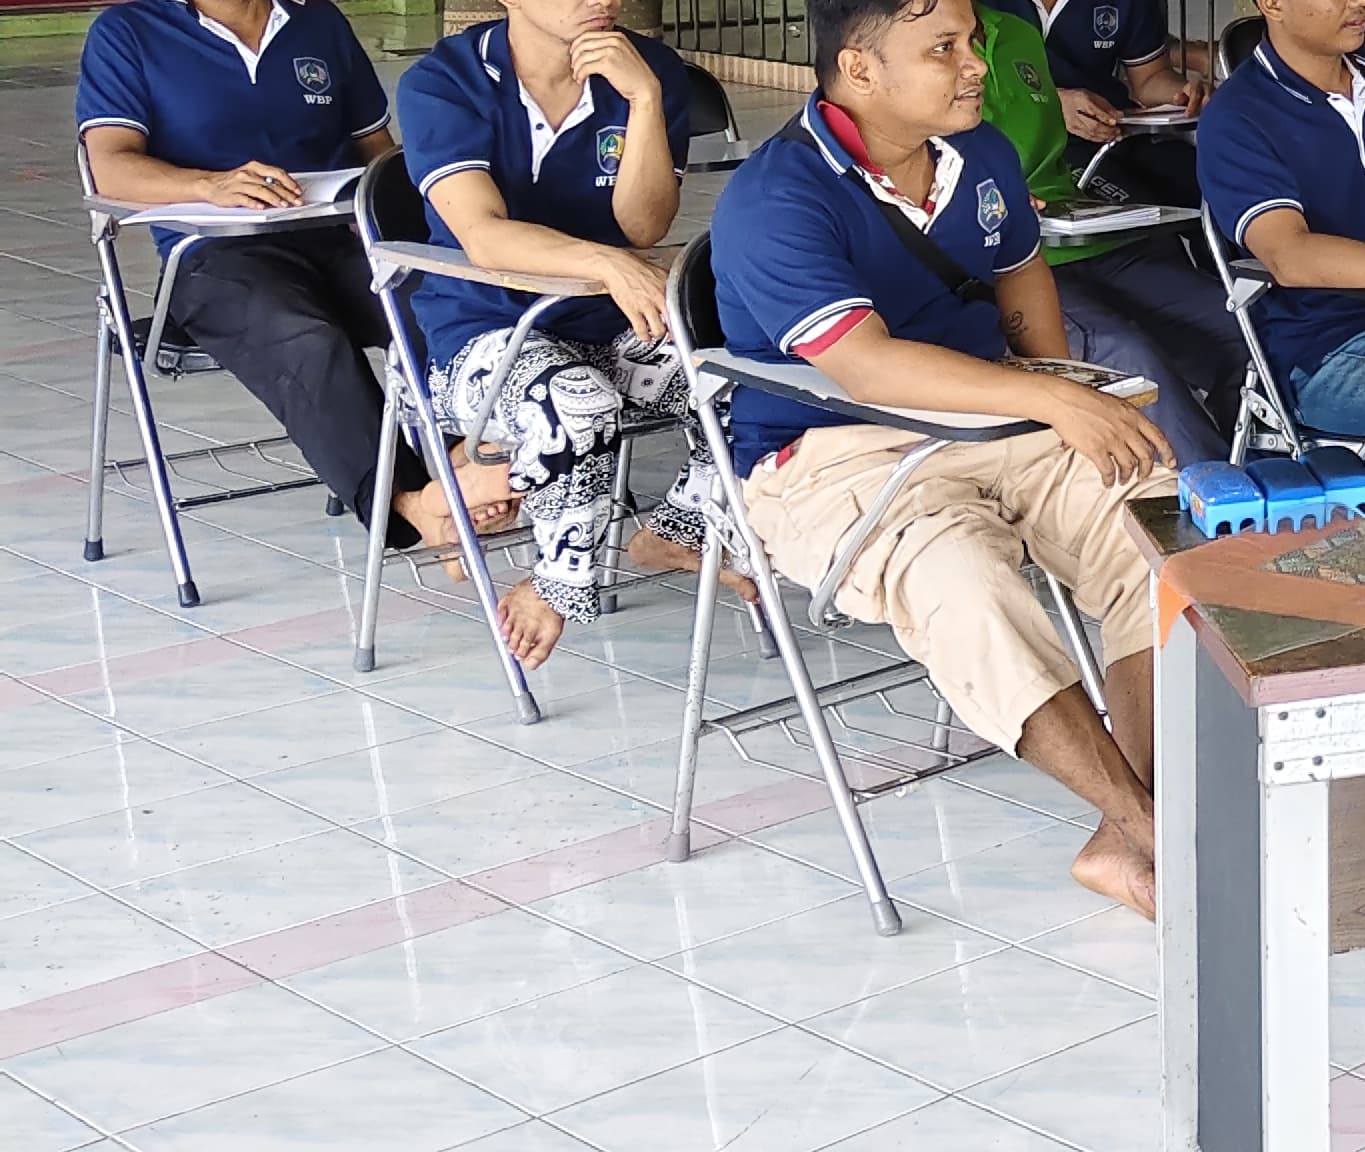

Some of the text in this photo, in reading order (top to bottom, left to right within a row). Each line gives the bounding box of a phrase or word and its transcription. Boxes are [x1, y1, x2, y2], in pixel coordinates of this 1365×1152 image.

[303, 94, 333, 105] WBP
[595, 175, 618, 187] WB
[1071, 167, 1130, 202] EGER
